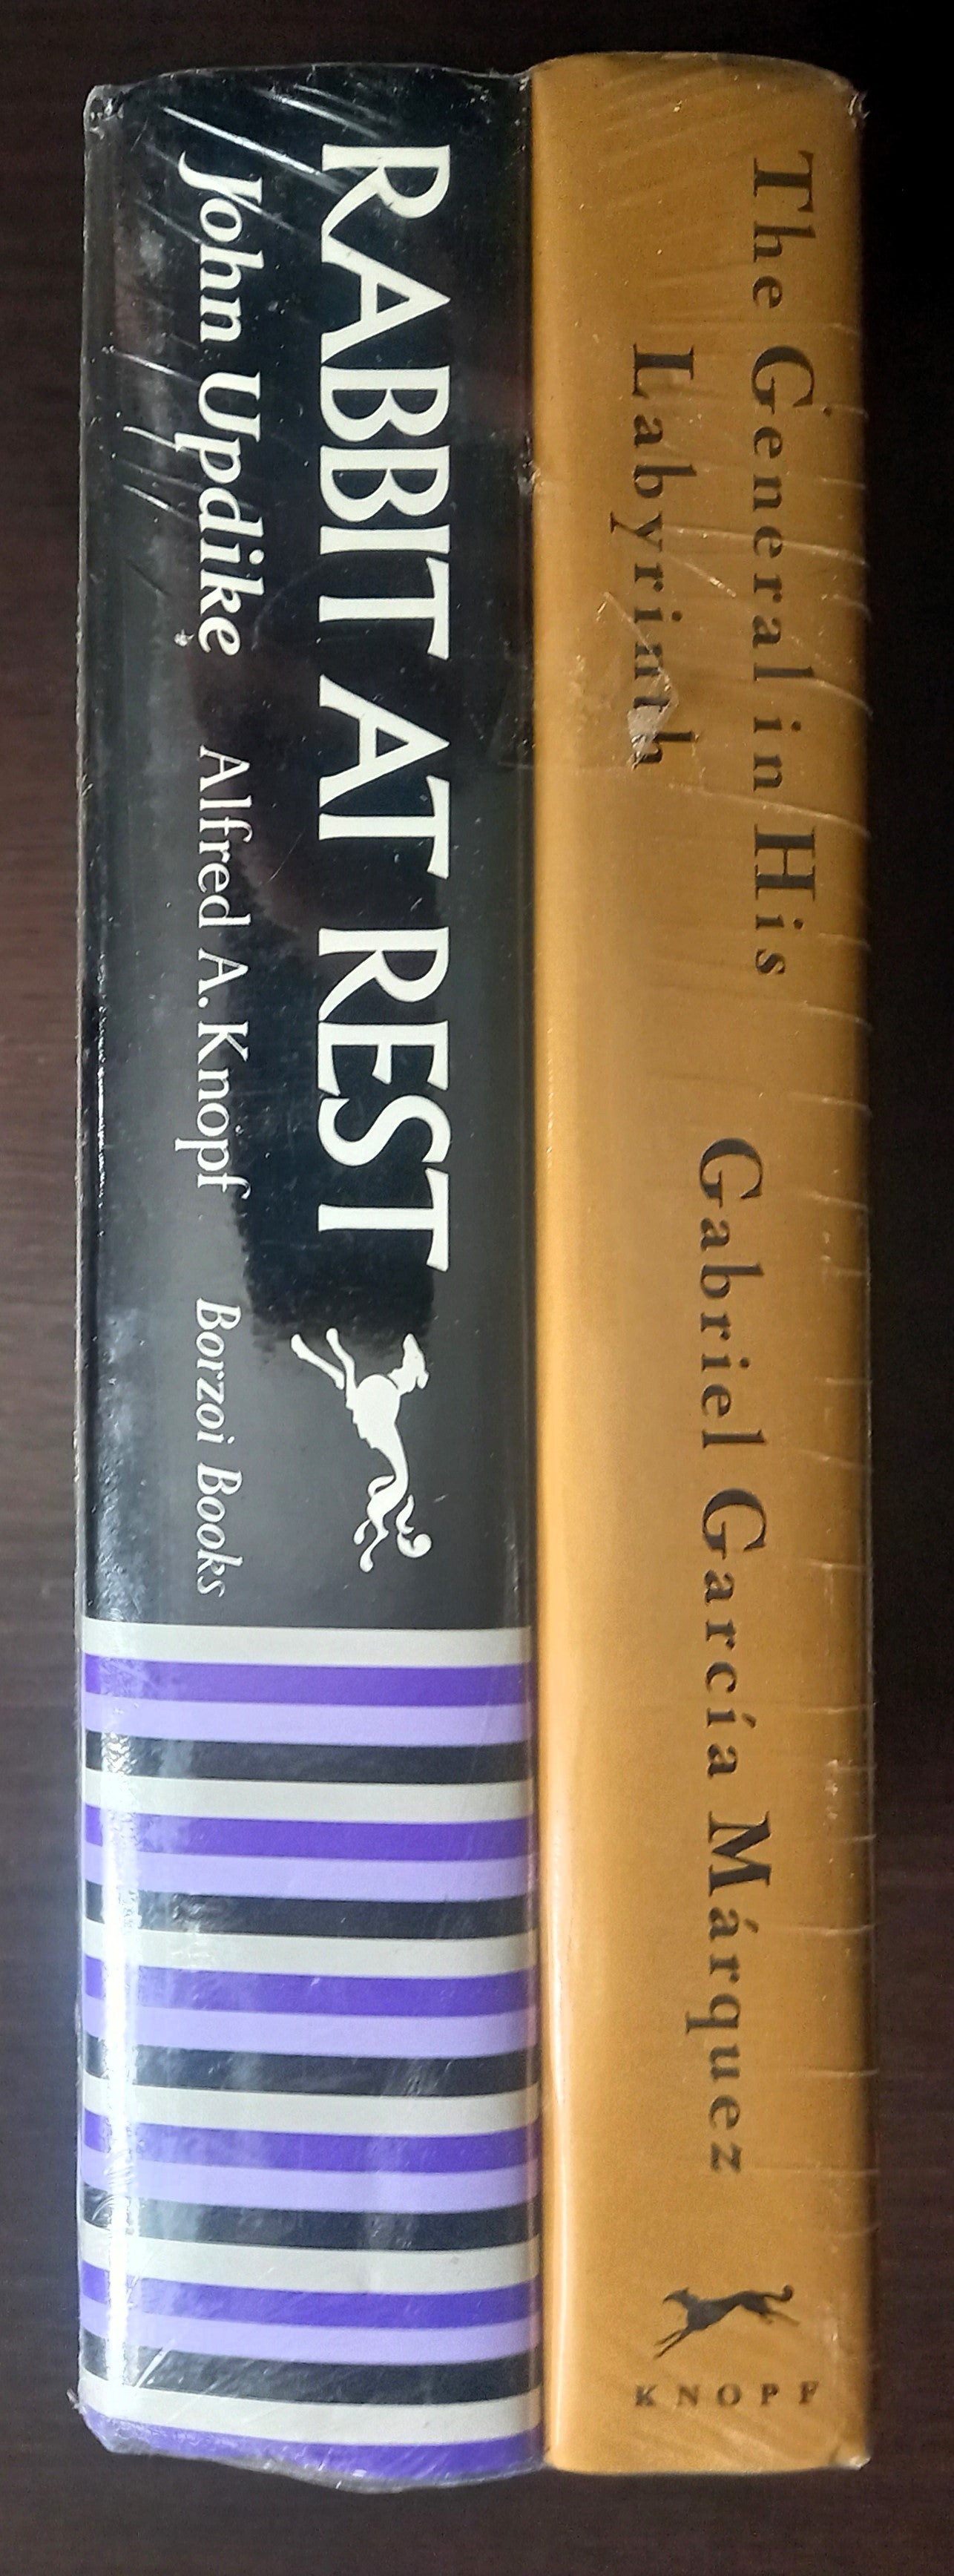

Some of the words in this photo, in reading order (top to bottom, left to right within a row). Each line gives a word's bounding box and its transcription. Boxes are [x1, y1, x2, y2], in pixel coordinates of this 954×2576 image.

[179, 151, 264, 343] John
[751, 150, 817, 310] The
[318, 144, 451, 660] RABBIT
[175, 372, 266, 657] Updike
[751, 345, 816, 681] General
[197, 745, 251, 928] Alfred
[318, 675, 451, 878] AT
[752, 712, 800, 792] in
[197, 949, 249, 1009] A.
[753, 825, 817, 976] His
[174, 1020, 251, 1198] Knopf
[318, 927, 451, 1271] REST
[195, 1298, 242, 1442] Borzoi
[697, 1138, 765, 1450] Gabriel
[196, 1463, 243, 1597] Books
[700, 1488, 767, 1779] García
[685, 1810, 772, 2174] Márquez
[634, 2380, 820, 2407] KNOPF
